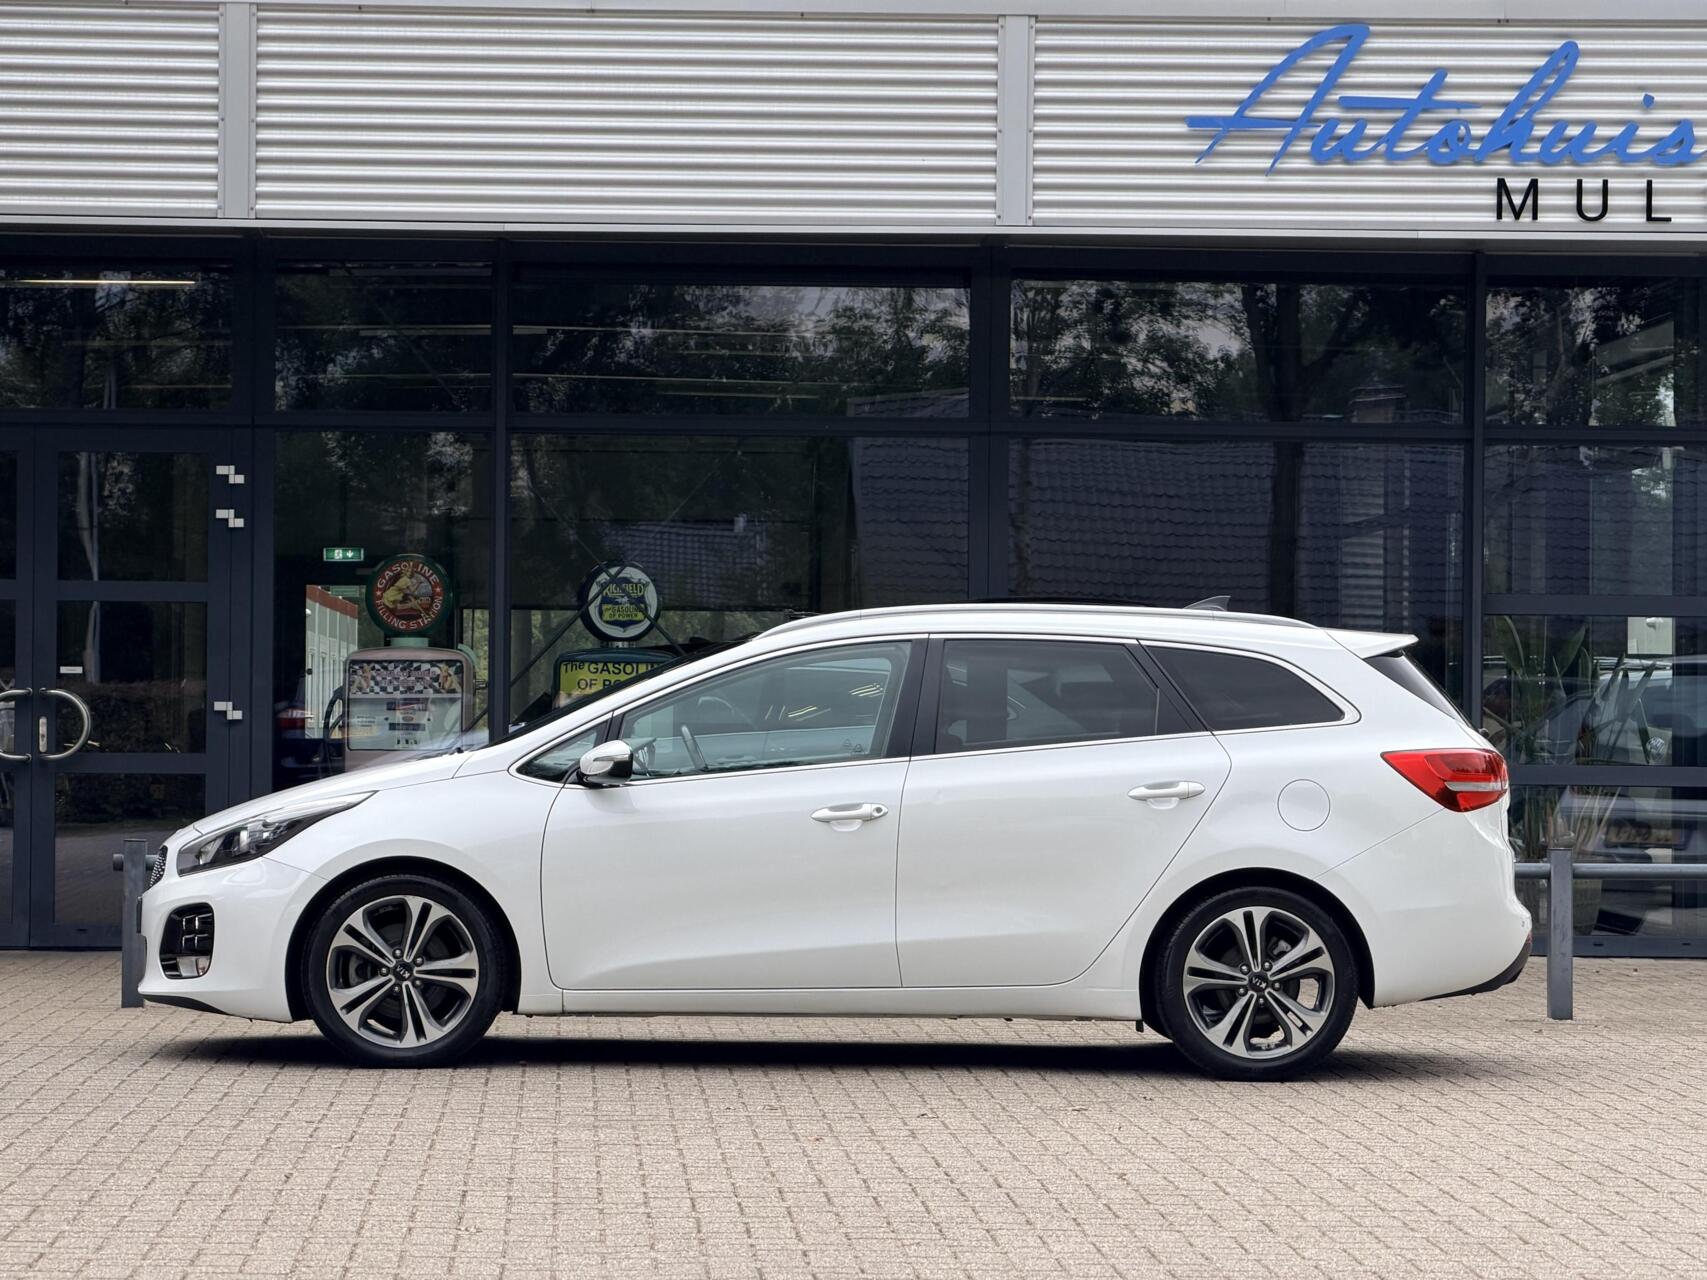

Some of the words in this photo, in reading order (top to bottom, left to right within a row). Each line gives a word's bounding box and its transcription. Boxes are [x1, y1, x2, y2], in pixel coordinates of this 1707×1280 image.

[1185, 23, 1707, 177] Autohuis
[377, 561, 440, 588] GASOLINE
[376, 598, 407, 629] FILLING
[409, 596, 444, 629] STATION
[563, 660, 585, 673] The
[577, 678, 598, 690] OF
